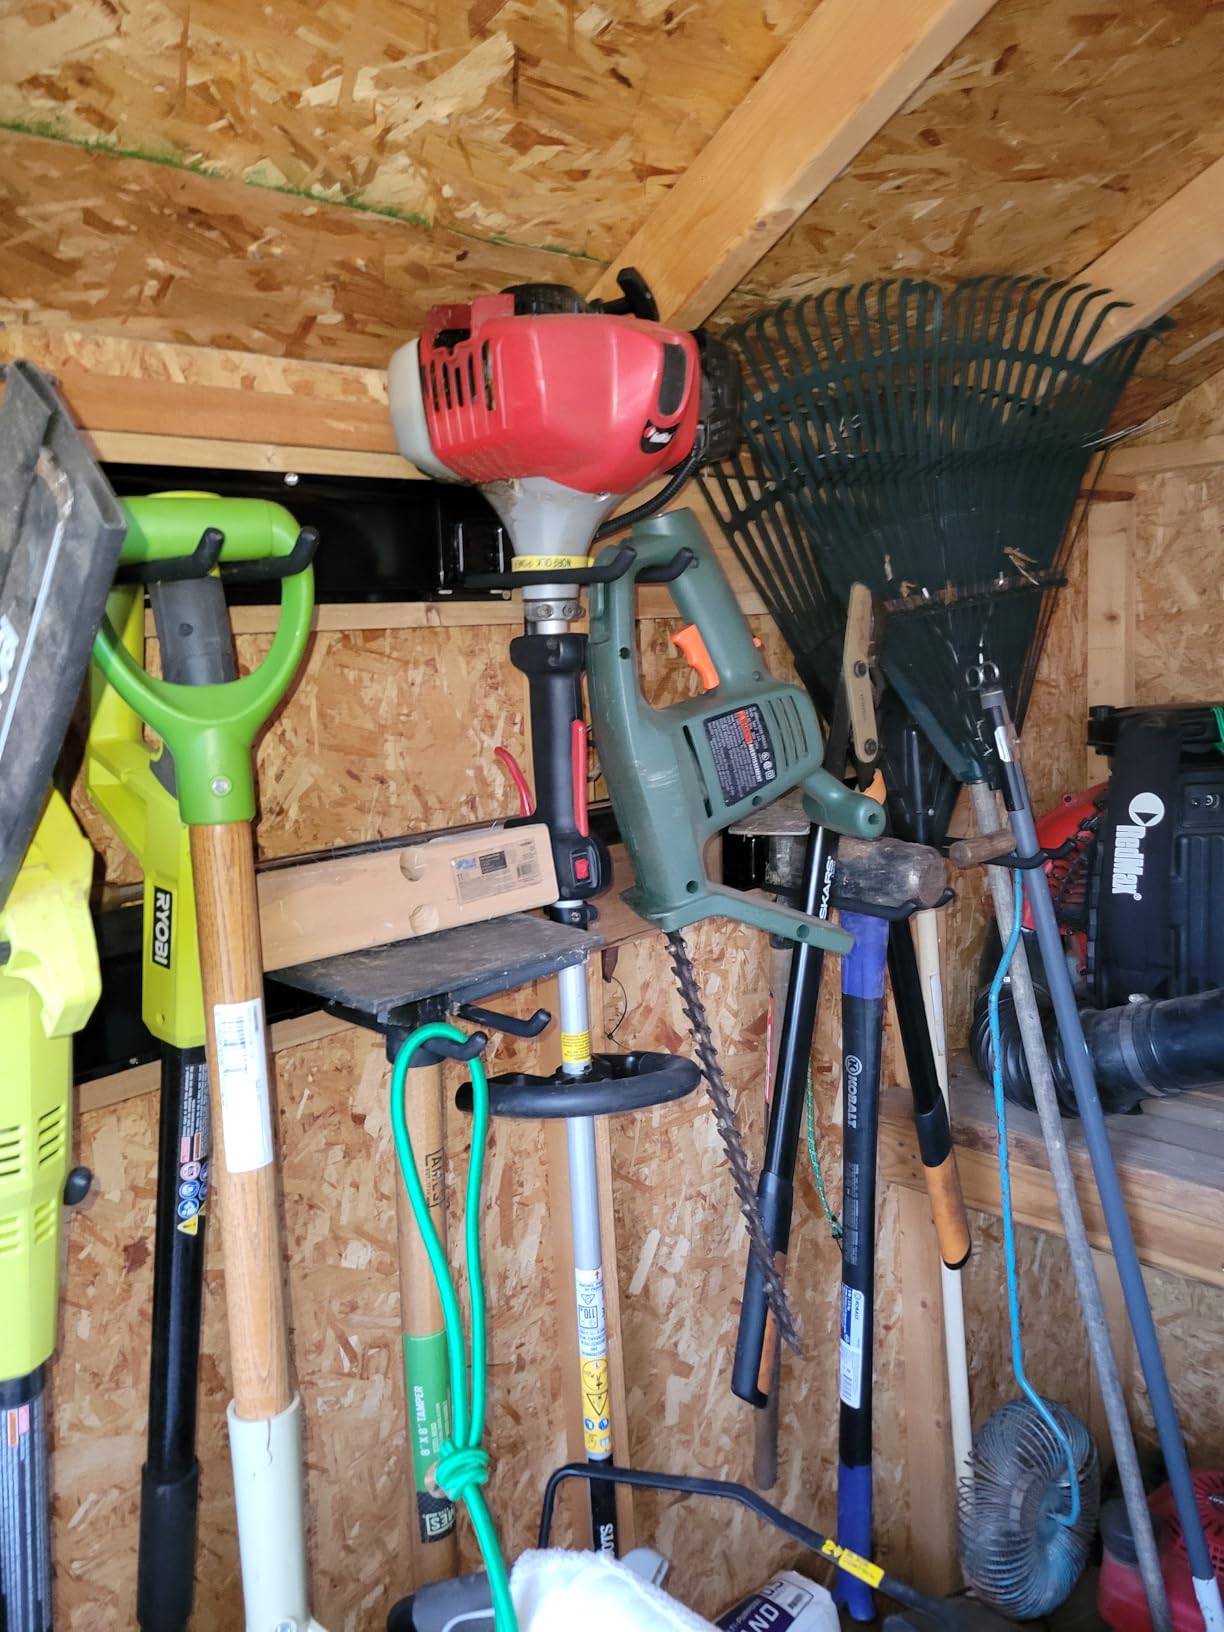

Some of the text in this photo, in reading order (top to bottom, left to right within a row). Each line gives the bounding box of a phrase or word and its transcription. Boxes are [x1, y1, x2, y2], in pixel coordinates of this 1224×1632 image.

[819, 859, 834, 920] SKARS
[154, 891, 171, 966] RYOBI
[847, 1075, 858, 1129] KOBALT
[413, 1385, 427, 1422] TAMPER
[744, 1602, 780, 1632] ND
